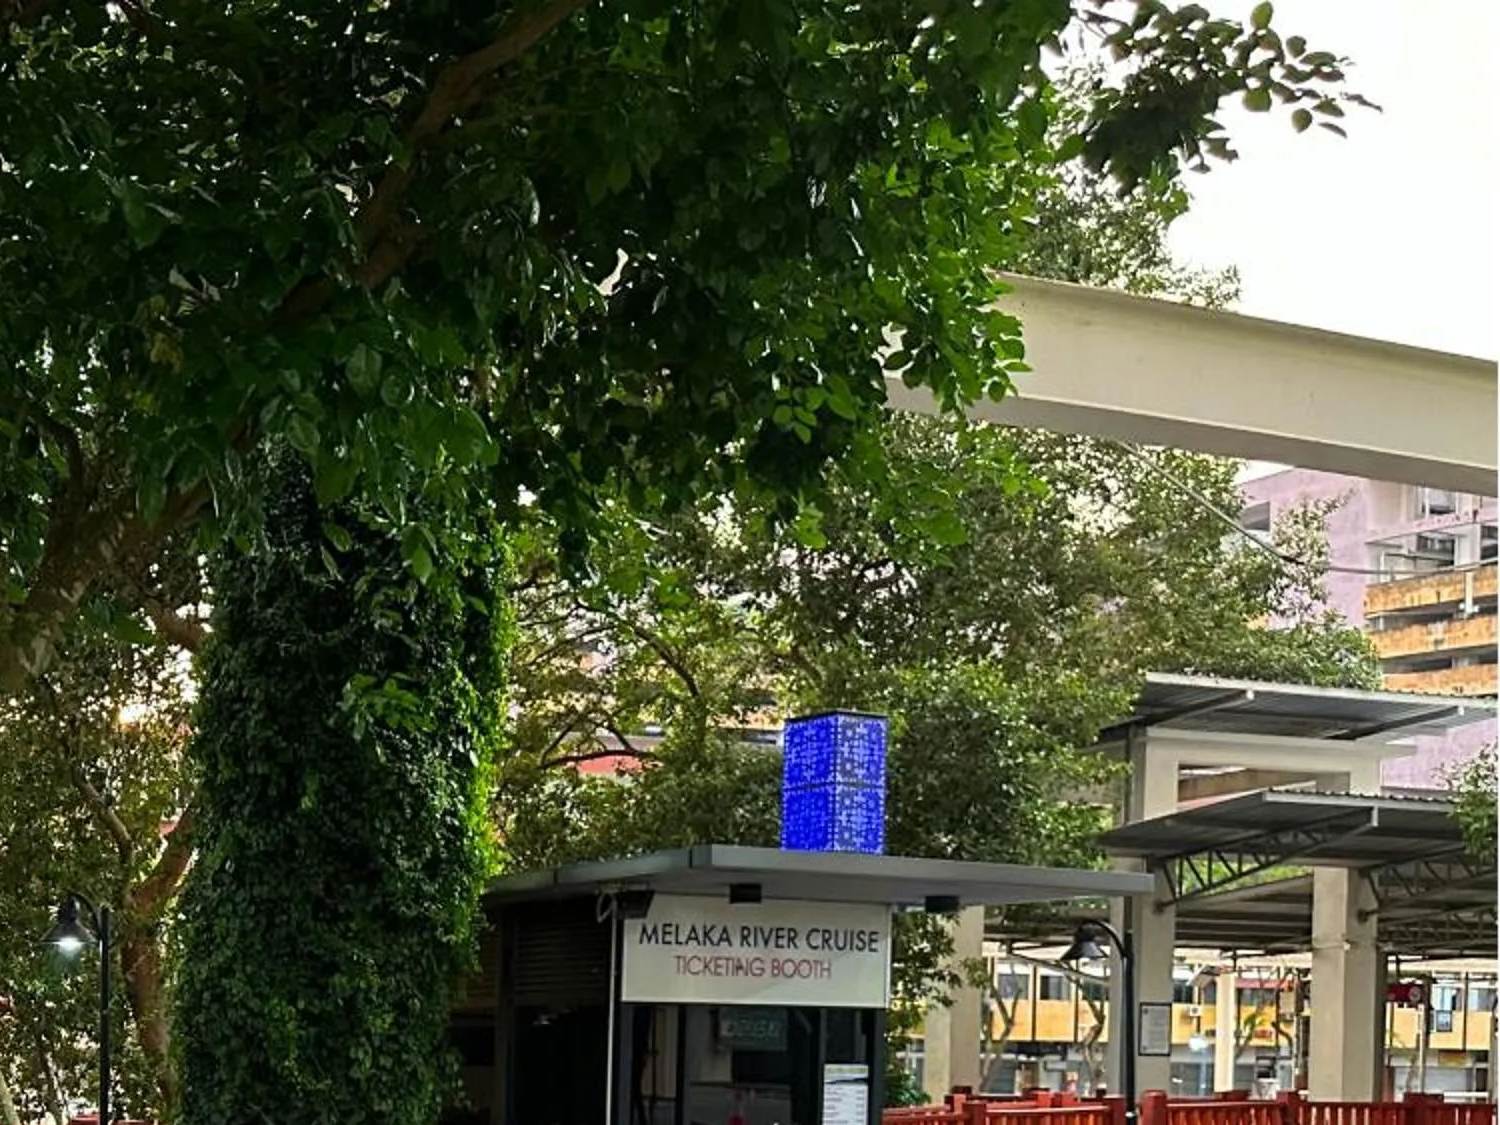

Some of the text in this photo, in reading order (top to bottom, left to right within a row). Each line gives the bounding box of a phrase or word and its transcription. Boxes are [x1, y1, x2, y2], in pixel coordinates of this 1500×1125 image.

[639, 923, 880, 952] MELAKA RIVER CRUISE
[675, 955, 831, 978] TICKETING BOOTH
